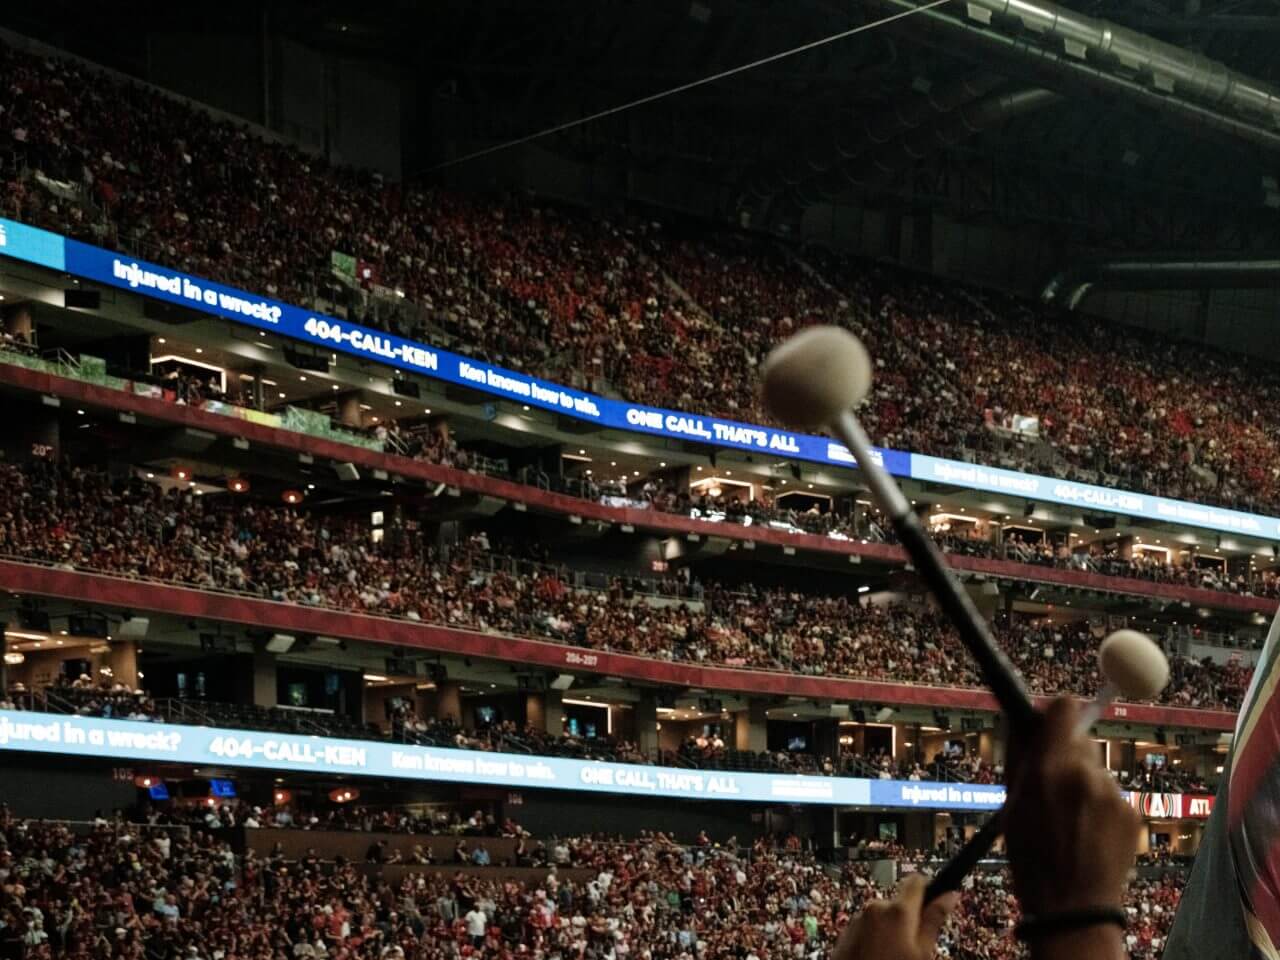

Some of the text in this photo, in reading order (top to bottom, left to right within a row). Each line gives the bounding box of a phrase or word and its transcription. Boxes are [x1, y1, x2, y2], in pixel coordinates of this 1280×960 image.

[113, 259, 282, 324] Injured in a wreck?
[304, 317, 438, 371] 404-CALL-KEN
[459, 361, 487, 383] Ken
[626, 408, 799, 452] ONE CALL, THAT'S ALL
[63, 721, 86, 745] in
[88, 729, 105, 746] a
[107, 730, 182, 751] wreck?
[209, 736, 367, 767] 404-CALL-KEN
[580, 766, 740, 794] ONE CALL, THAT'S ALL
[1189, 798, 1212, 816] ATL
